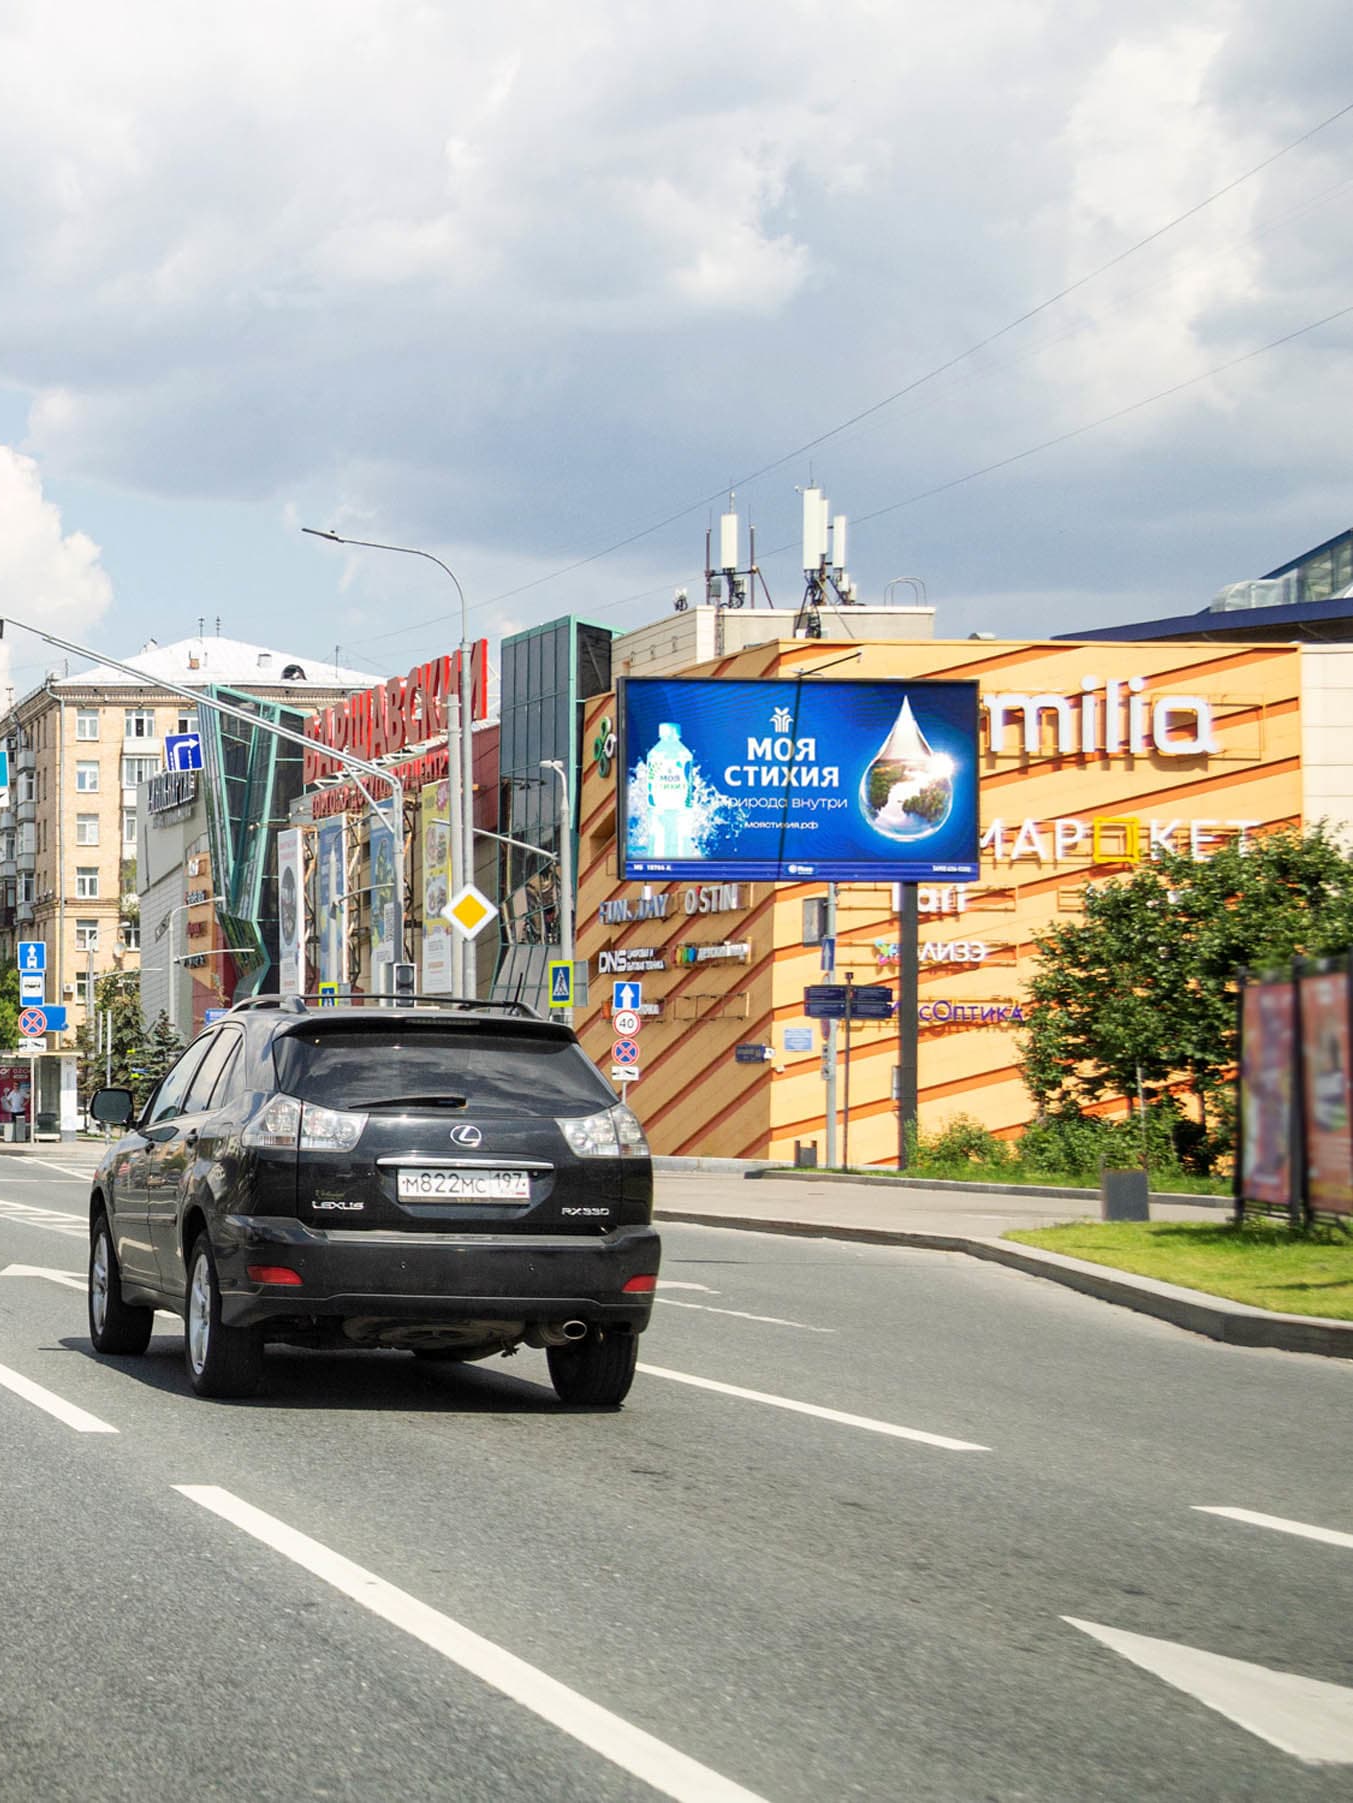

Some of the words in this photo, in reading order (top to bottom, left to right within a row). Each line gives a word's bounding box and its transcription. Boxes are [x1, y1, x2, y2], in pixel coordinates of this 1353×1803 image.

[747, 737, 816, 761] МОЯ
[724, 766, 840, 788] СТИХИЯ
[792, 798, 848, 811] внутри
[599, 949, 626, 974] DNS
[619, 1017, 635, 1029] 40
[405, 1172, 487, 1194] М822МС
[495, 1172, 522, 1189] 197
[311, 1200, 365, 1210] LEXUS
